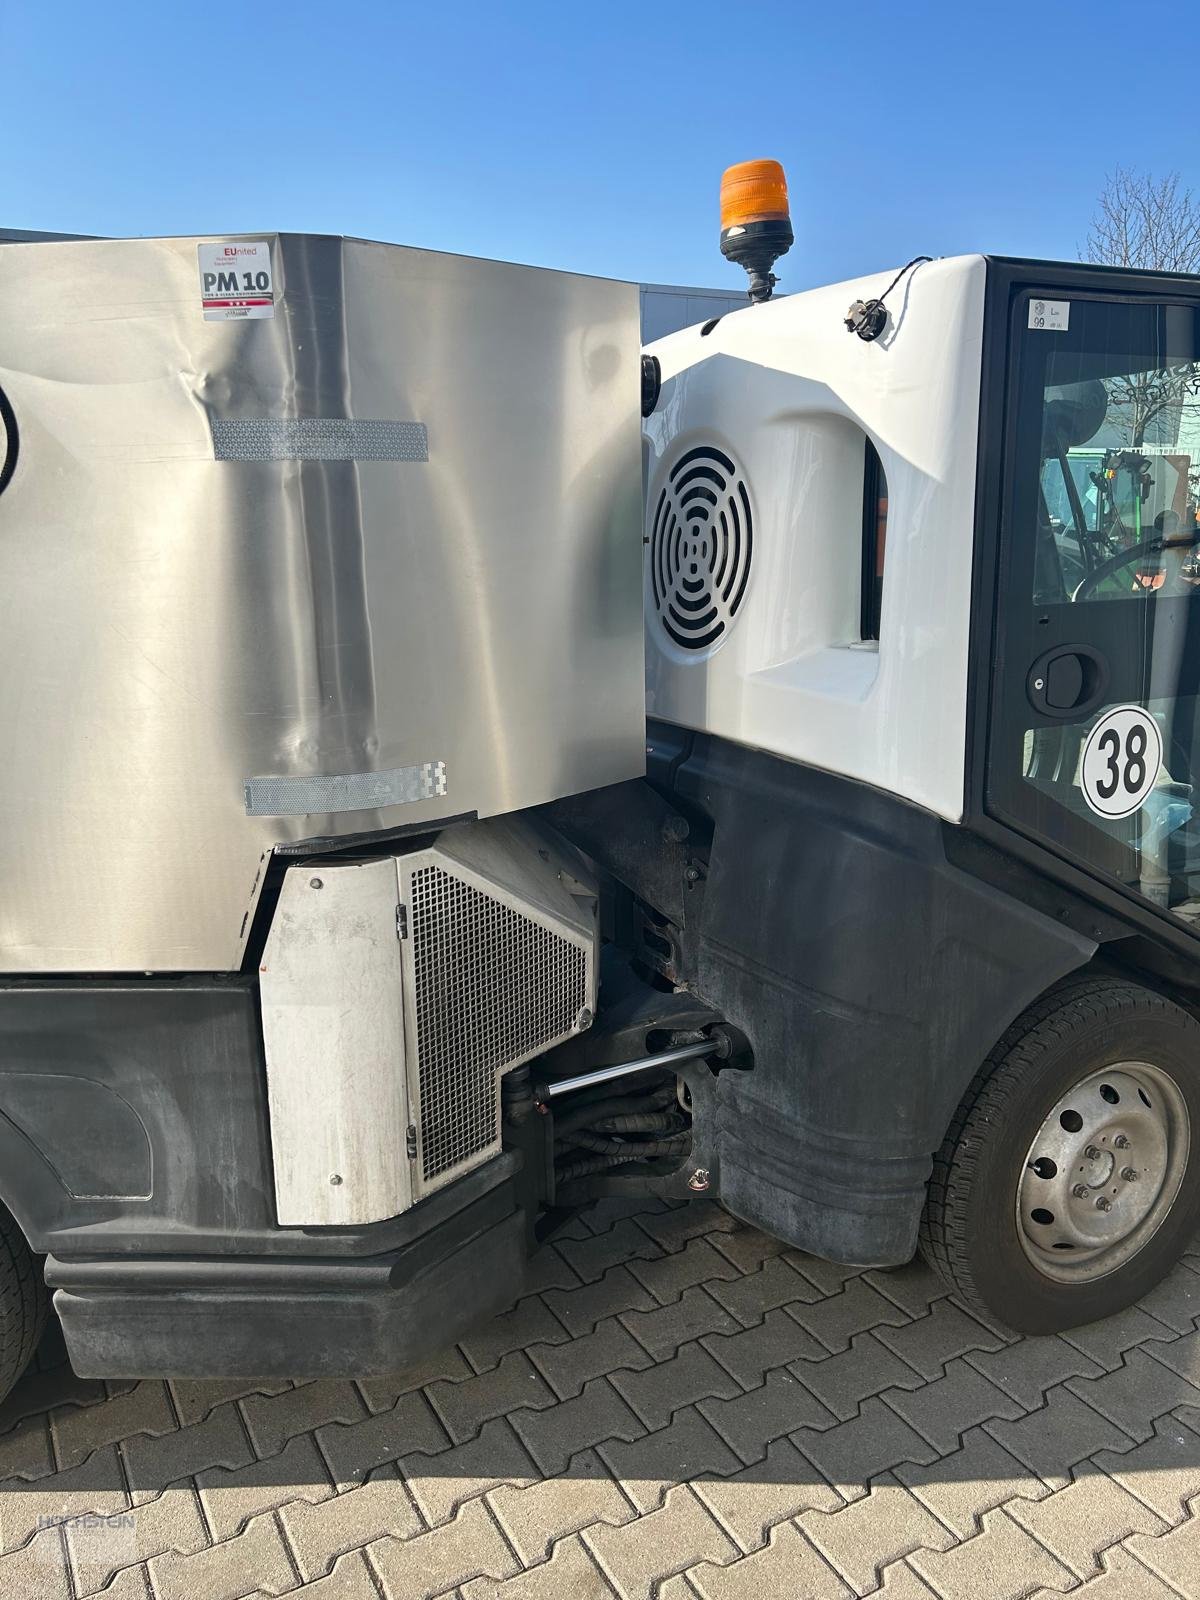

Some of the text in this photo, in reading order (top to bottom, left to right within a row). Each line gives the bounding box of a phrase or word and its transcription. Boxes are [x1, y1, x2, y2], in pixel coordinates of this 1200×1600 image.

[224, 247, 257, 256] EUnited
[203, 271, 270, 292] PM 10
[1034, 316, 1045, 328] 99
[1096, 724, 1148, 799] 38
